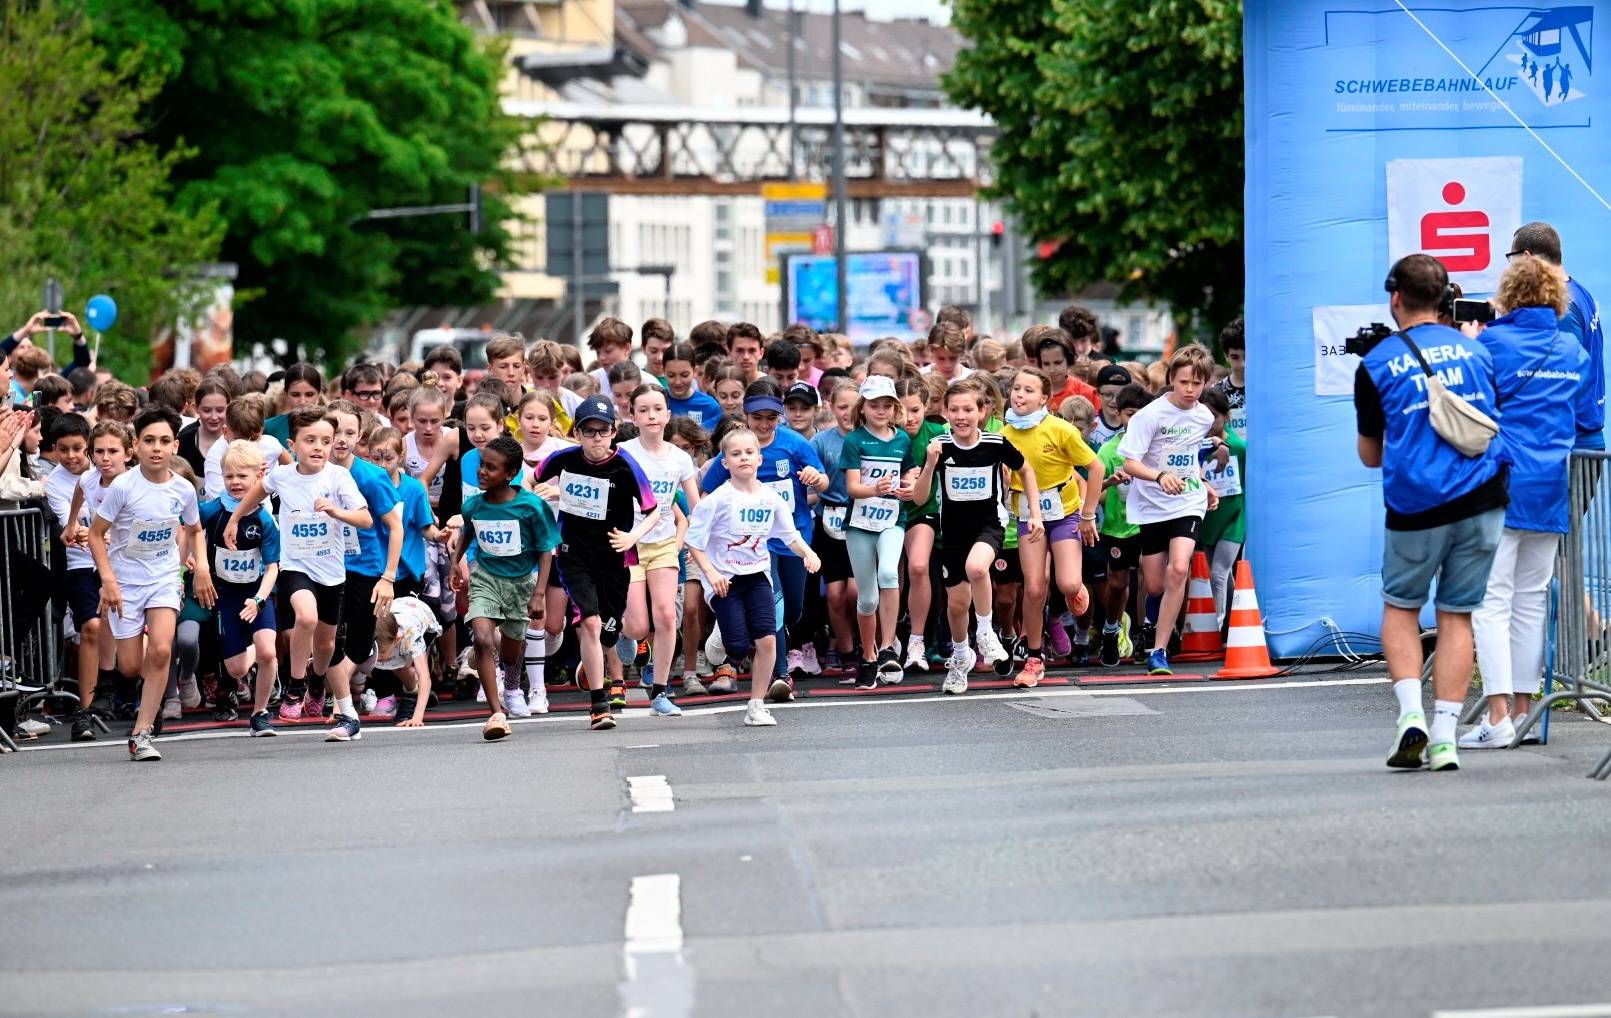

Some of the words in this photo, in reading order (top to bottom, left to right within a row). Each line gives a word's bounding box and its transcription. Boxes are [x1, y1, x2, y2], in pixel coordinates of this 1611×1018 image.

[1334, 77, 1519, 94] SCHWEBEBAHNLAUF
[1166, 454, 1195, 466] 3851
[652, 480, 674, 494] 231
[951, 477, 986, 489] 5258
[566, 483, 600, 500] 4231
[739, 508, 772, 522] 1097
[861, 505, 893, 521] 1707
[828, 516, 842, 528] 10
[137, 528, 172, 542] 4555
[291, 523, 328, 537] 4553
[479, 531, 513, 544] 4637
[223, 558, 255, 572] 1244
